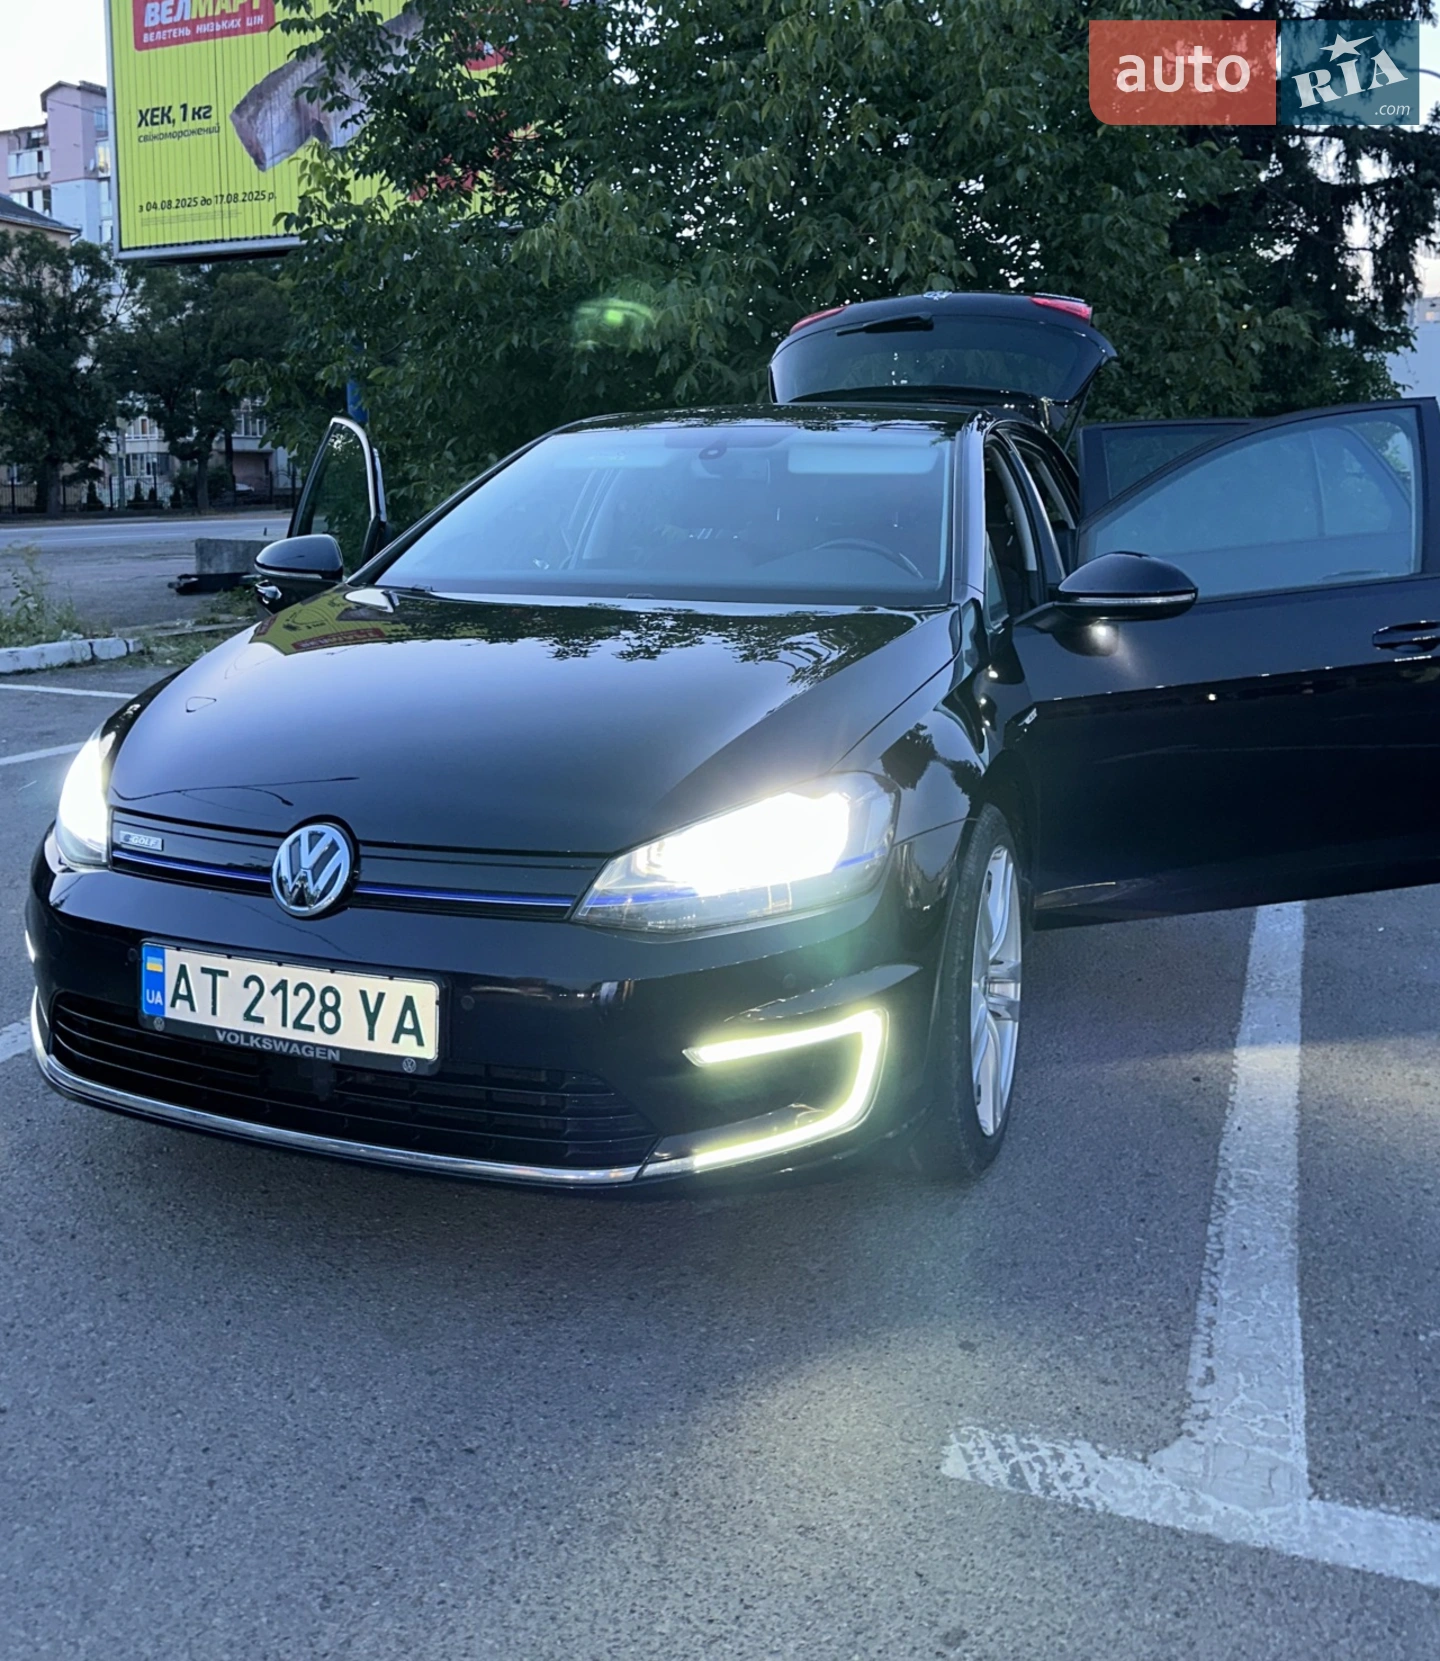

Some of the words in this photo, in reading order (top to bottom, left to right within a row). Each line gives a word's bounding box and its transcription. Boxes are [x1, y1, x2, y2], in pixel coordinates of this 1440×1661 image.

[142, 26, 191, 43] ВЕЛЕТЕНЬ
[196, 18, 241, 35] НИЗЬКИХ
[246, 14, 264, 27] ЦІН
[137, 104, 176, 128] ХЕК,
[180, 102, 188, 122] 1
[191, 104, 213, 121] кг
[137, 122, 220, 143] свіжоморожений
[145, 196, 199, 212] 04.08.2025
[199, 196, 213, 207] до
[214, 190, 267, 205] 17.08.2025
[146, 989, 163, 1006] UA
[169, 963, 229, 1016] AT
[242, 974, 342, 1035] 2128
[359, 989, 425, 1047] YA
[215, 1029, 341, 1062] VOLKSWAGEN
